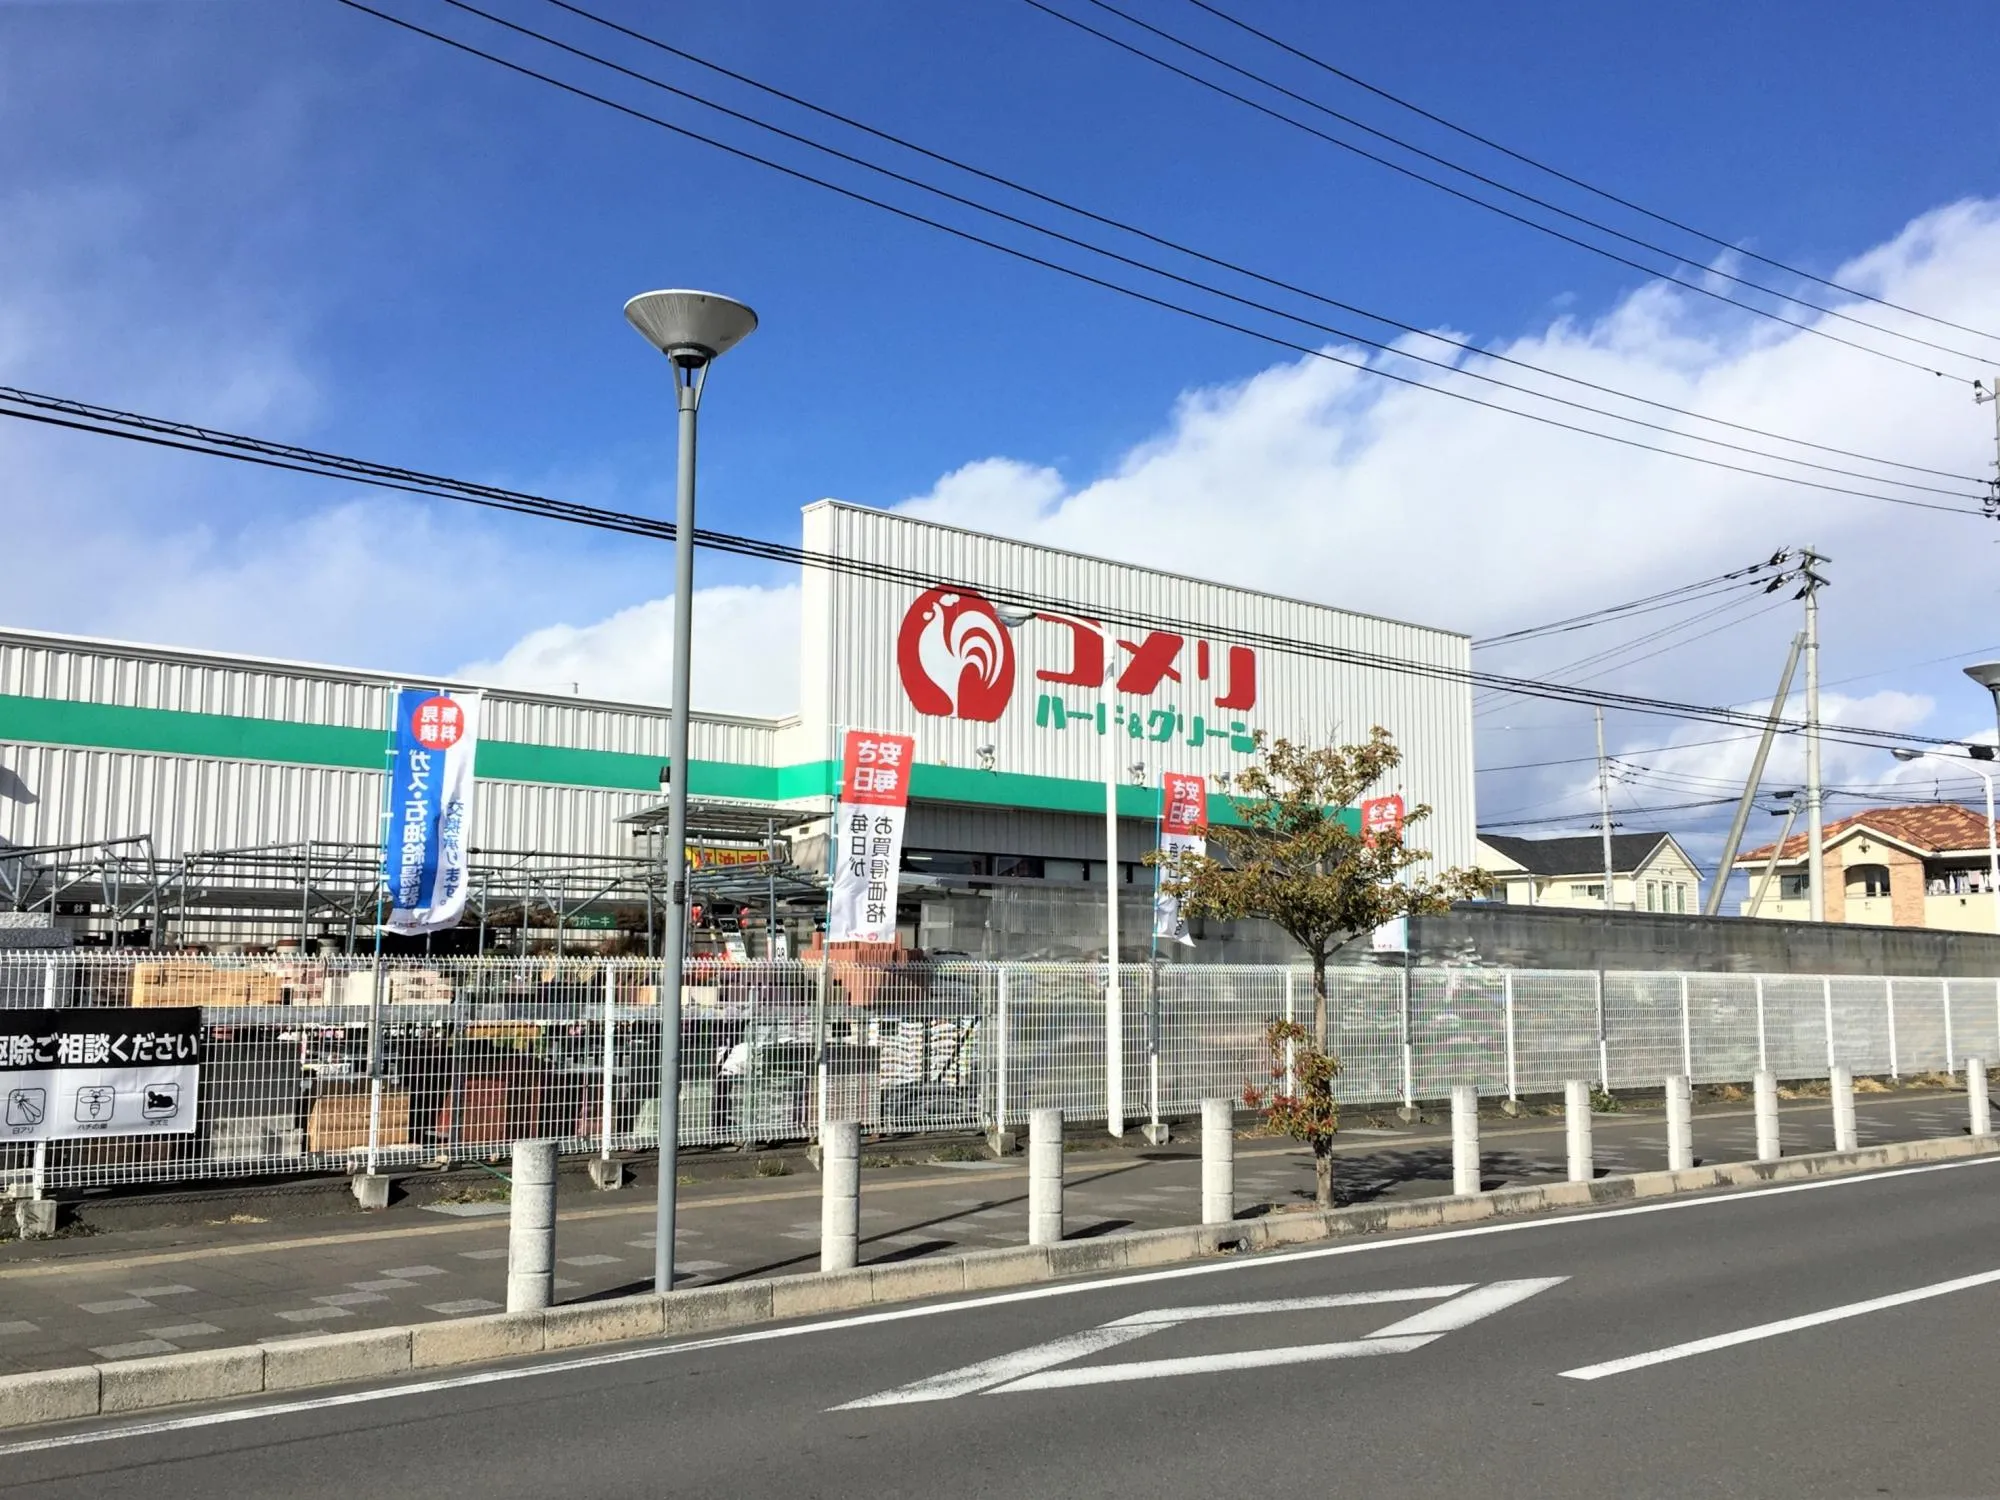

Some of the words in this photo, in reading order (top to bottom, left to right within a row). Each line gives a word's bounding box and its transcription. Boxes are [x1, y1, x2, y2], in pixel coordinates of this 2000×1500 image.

[1036, 610, 1256, 711] コメリ
[1036, 694, 1256, 754] ハード&グリーン
